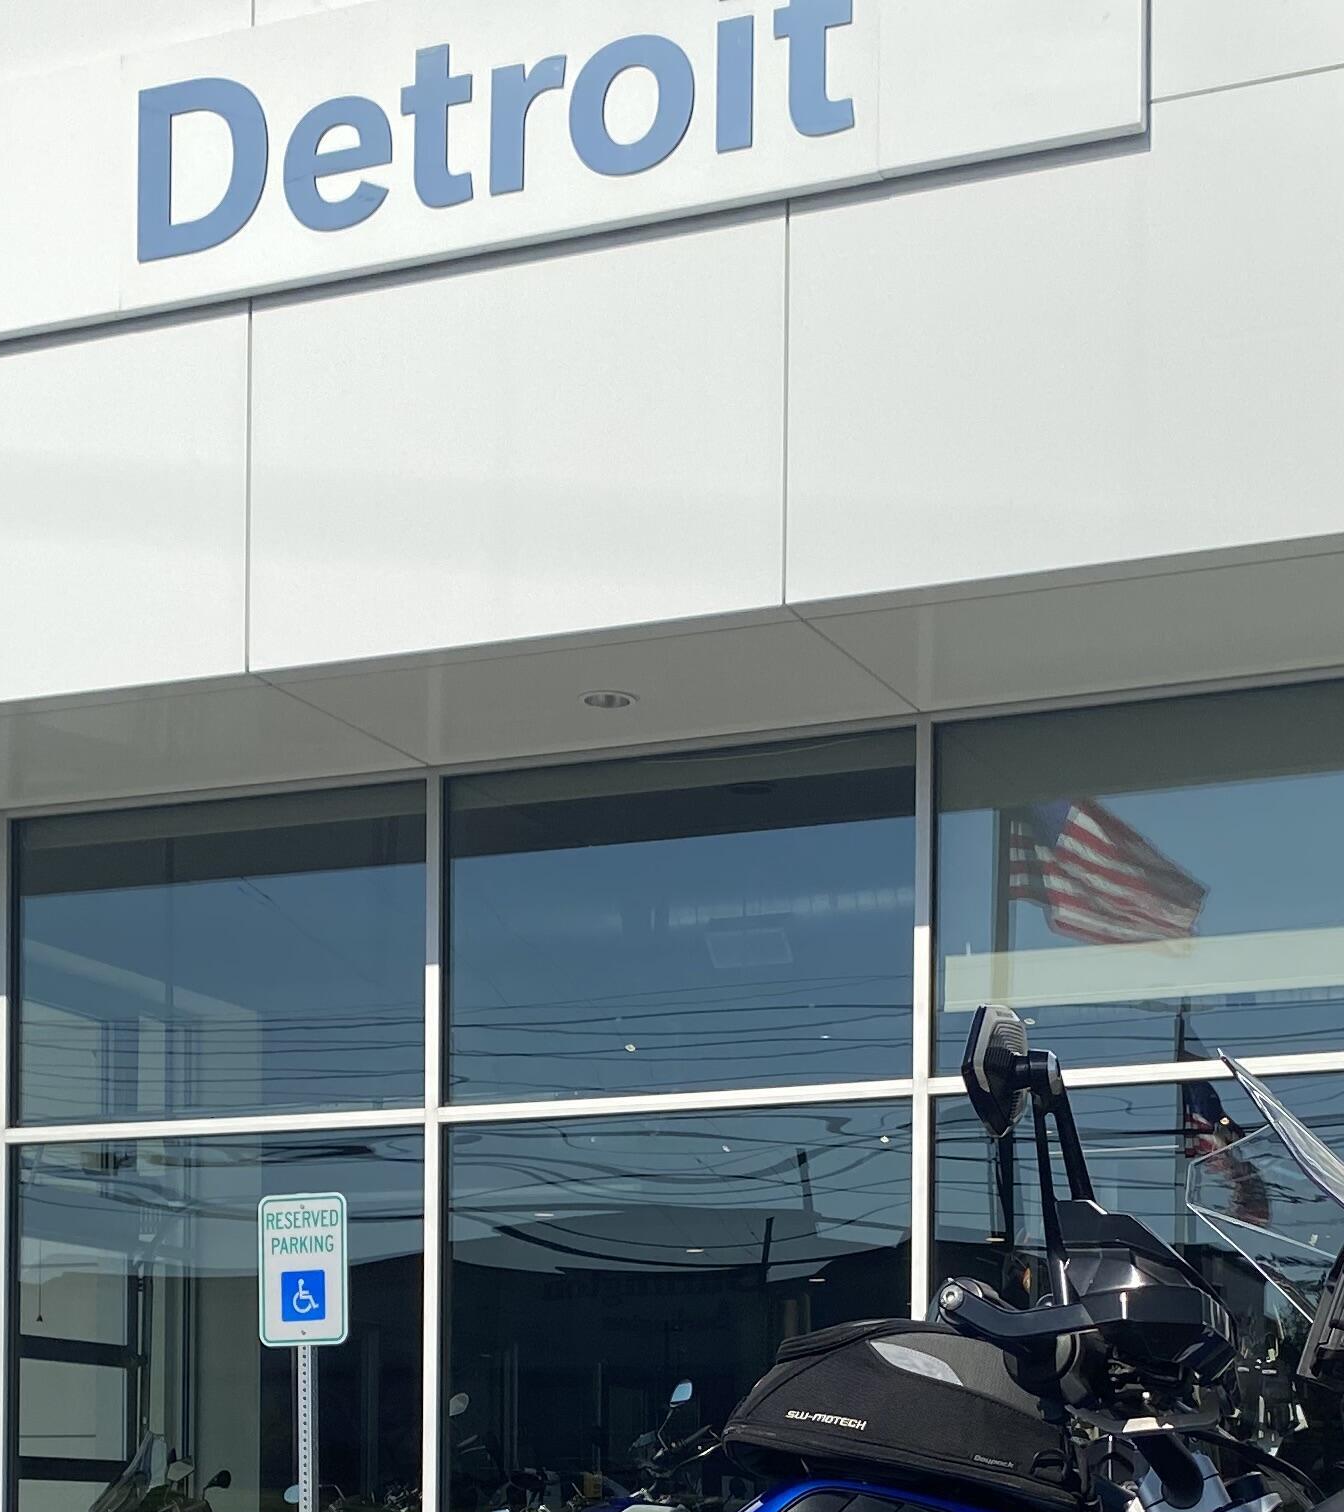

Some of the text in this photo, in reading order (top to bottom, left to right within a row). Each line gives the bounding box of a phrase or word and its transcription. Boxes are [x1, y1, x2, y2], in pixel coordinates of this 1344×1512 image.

[137, 0, 855, 263] Detroit
[266, 1209, 339, 1230] RESERVED
[271, 1235, 334, 1255] PARKING
[785, 1410, 867, 1431] SW-MOTECH
